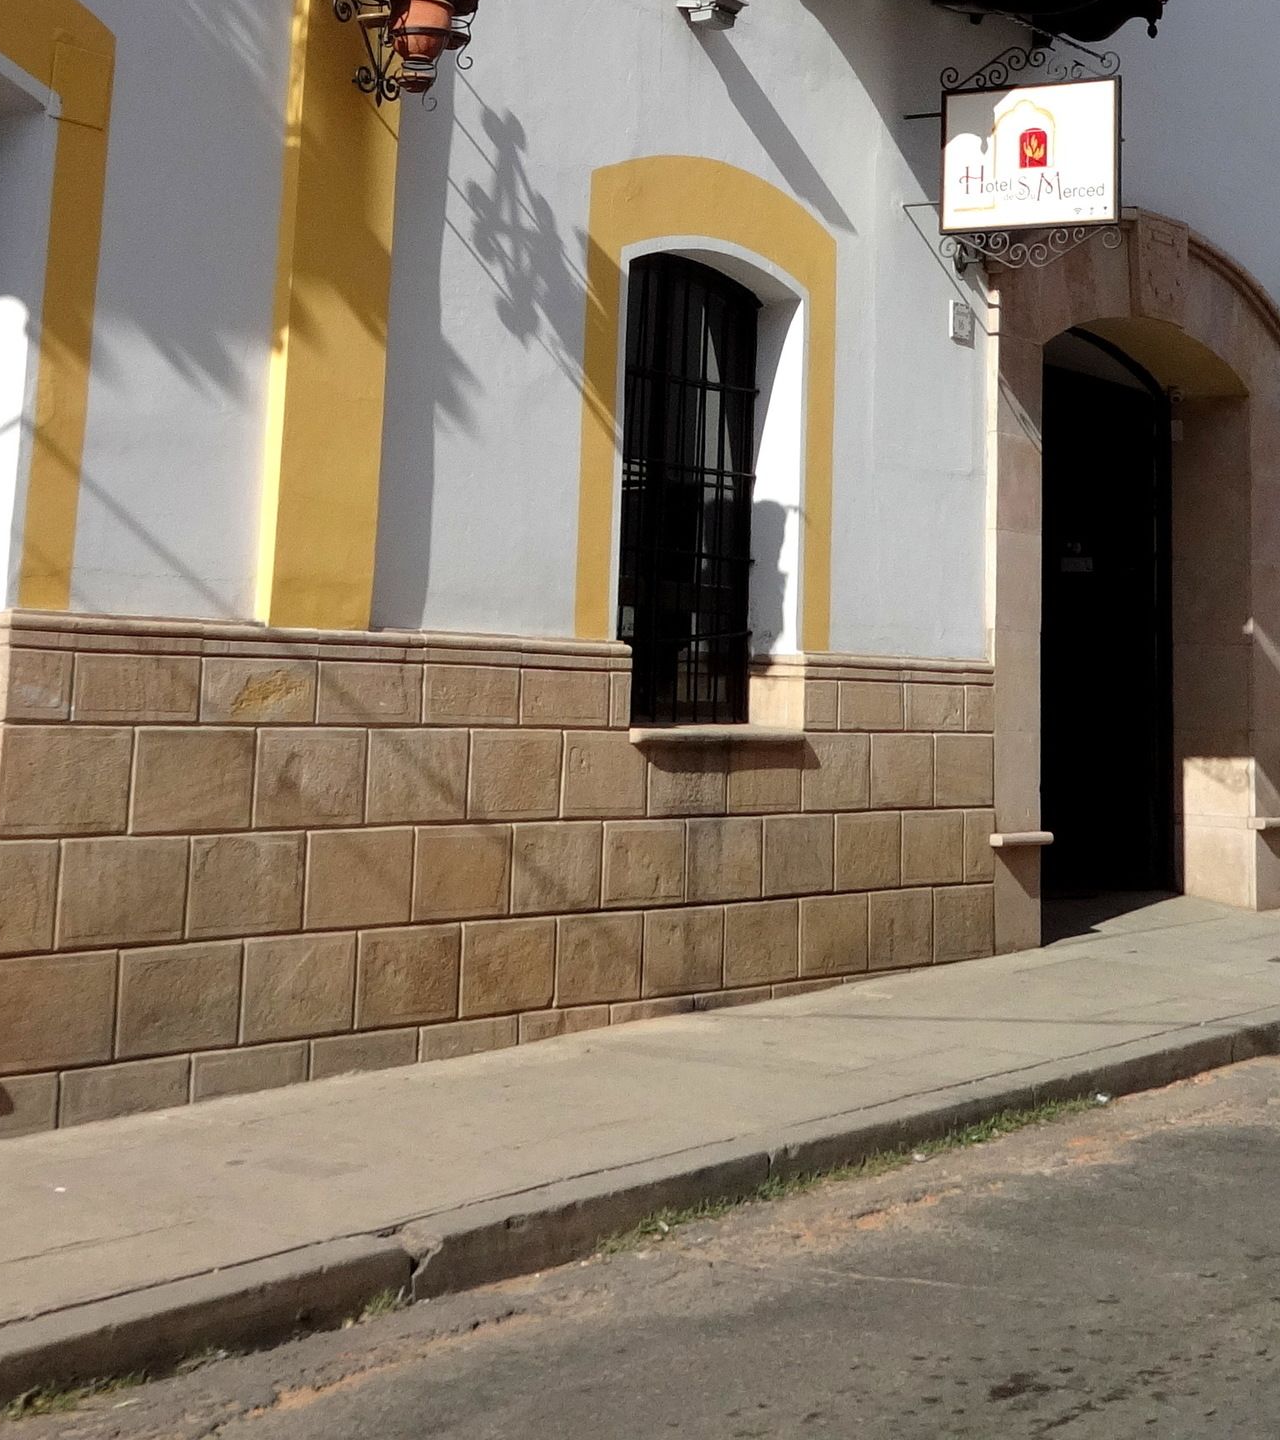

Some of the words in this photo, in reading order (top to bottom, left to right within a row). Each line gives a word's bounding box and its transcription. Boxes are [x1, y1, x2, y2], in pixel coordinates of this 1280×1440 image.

[959, 165, 1012, 194] Hotel
[1016, 176, 1036, 201] Su
[1037, 171, 1105, 201] Merced
